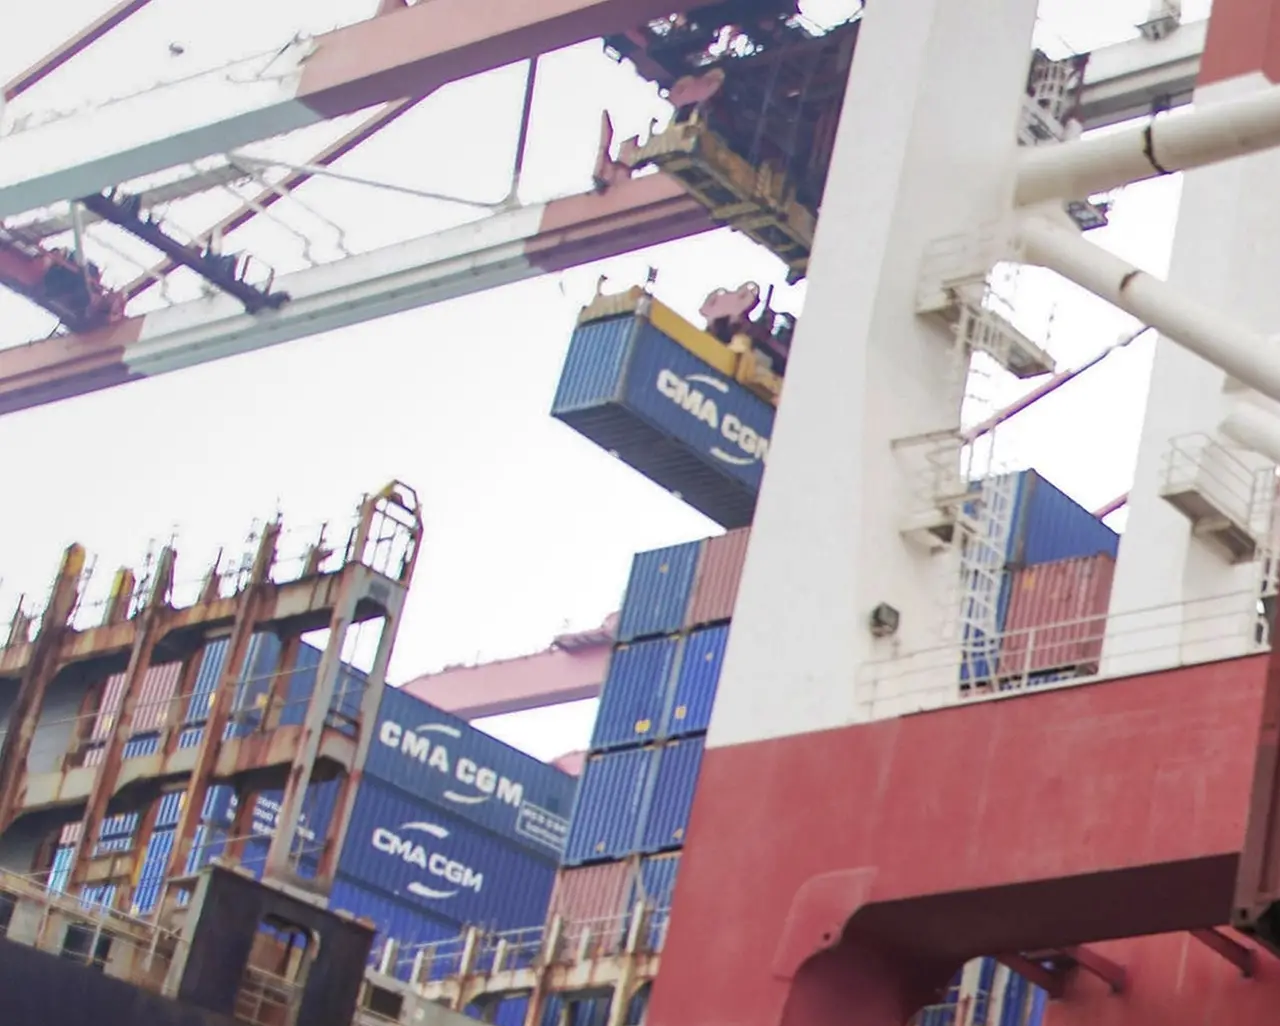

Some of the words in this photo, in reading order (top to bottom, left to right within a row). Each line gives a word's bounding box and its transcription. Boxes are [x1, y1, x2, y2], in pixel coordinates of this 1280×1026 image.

[656, 368, 719, 429] CMA
[379, 720, 449, 773] CMA
[455, 757, 524, 808] CGM
[372, 827, 427, 870] CMA
[428, 852, 484, 893] CGM
